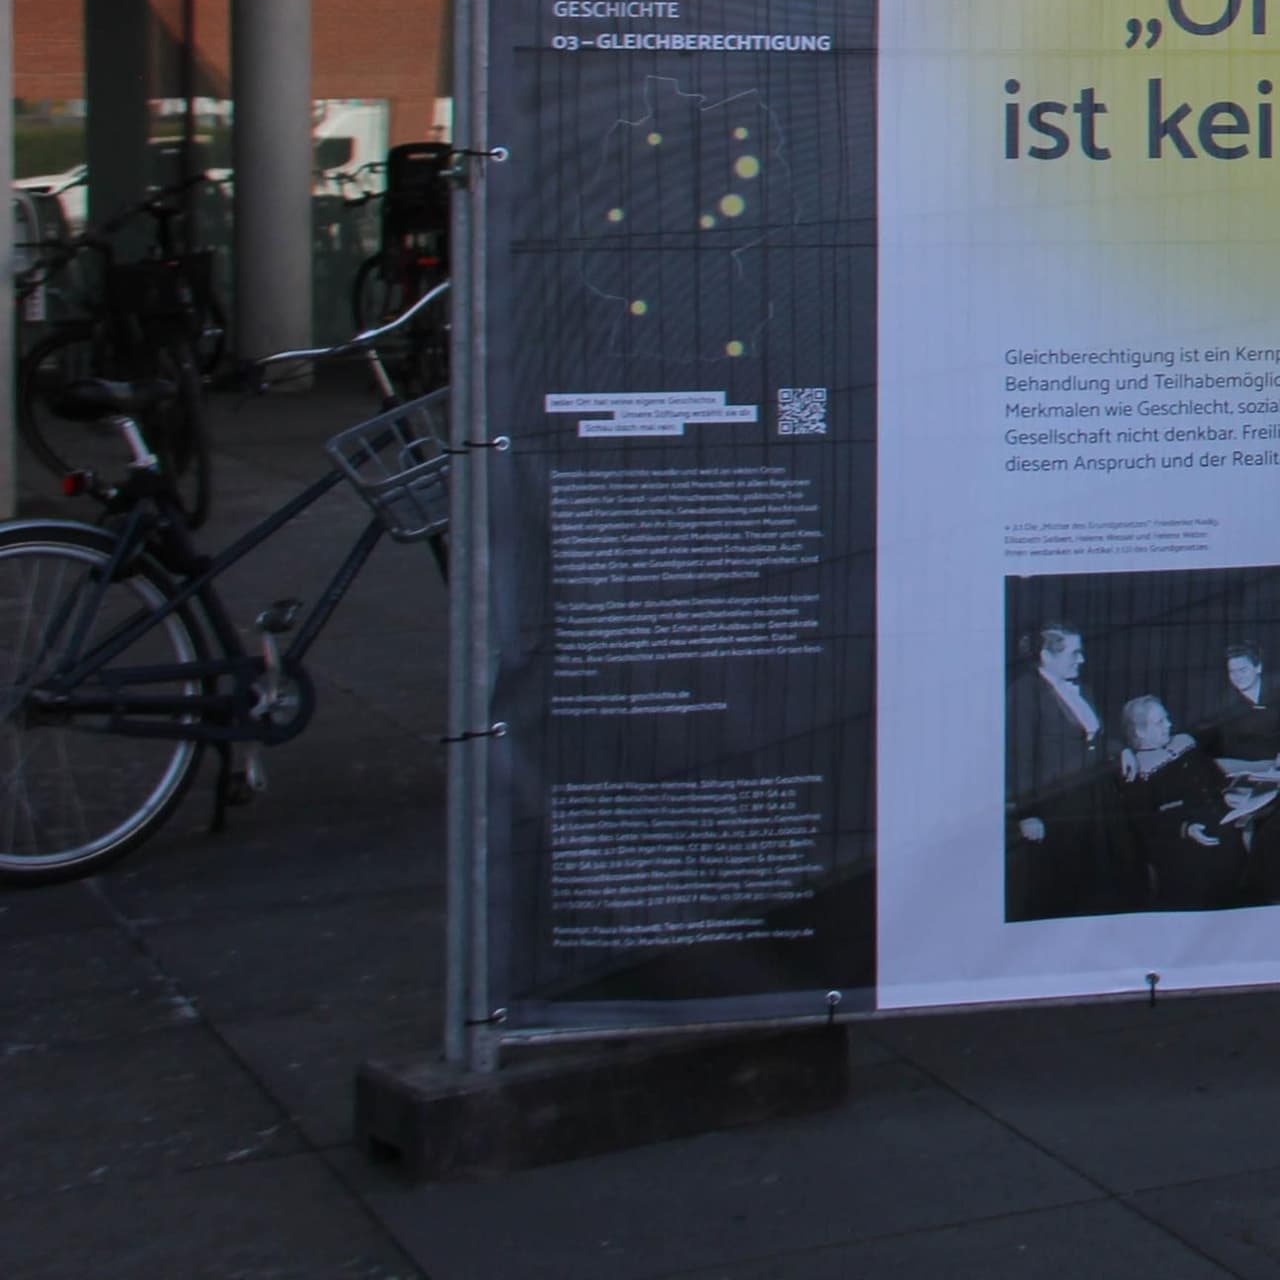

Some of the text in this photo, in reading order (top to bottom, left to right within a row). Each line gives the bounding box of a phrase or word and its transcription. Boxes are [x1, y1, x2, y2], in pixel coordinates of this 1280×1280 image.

[553, 1, 680, 19] GESCHICHTE
[597, 33, 831, 52] GLEICHBERECHTIGUNG
[1003, 79, 1111, 161] ist
[1005, 348, 1175, 368] Gleichberechtigung
[1179, 347, 1200, 362] ist
[1205, 347, 1230, 362] ein
[1005, 376, 1110, 395] Behandlung
[1116, 375, 1149, 390] und
[1005, 402, 1100, 418] Merkmalen
[1105, 402, 1132, 417] wie
[1138, 399, 1234, 417] Geschlecht,
[1005, 428, 1111, 445] Gesellschaft
[1116, 428, 1159, 443] nicht
[1164, 426, 1237, 443] denkbar.
[1005, 456, 1068, 472] diesem
[1073, 454, 1155, 474] Anspruch
[1161, 452, 1193, 468] und
[1200, 452, 1226, 467] der
